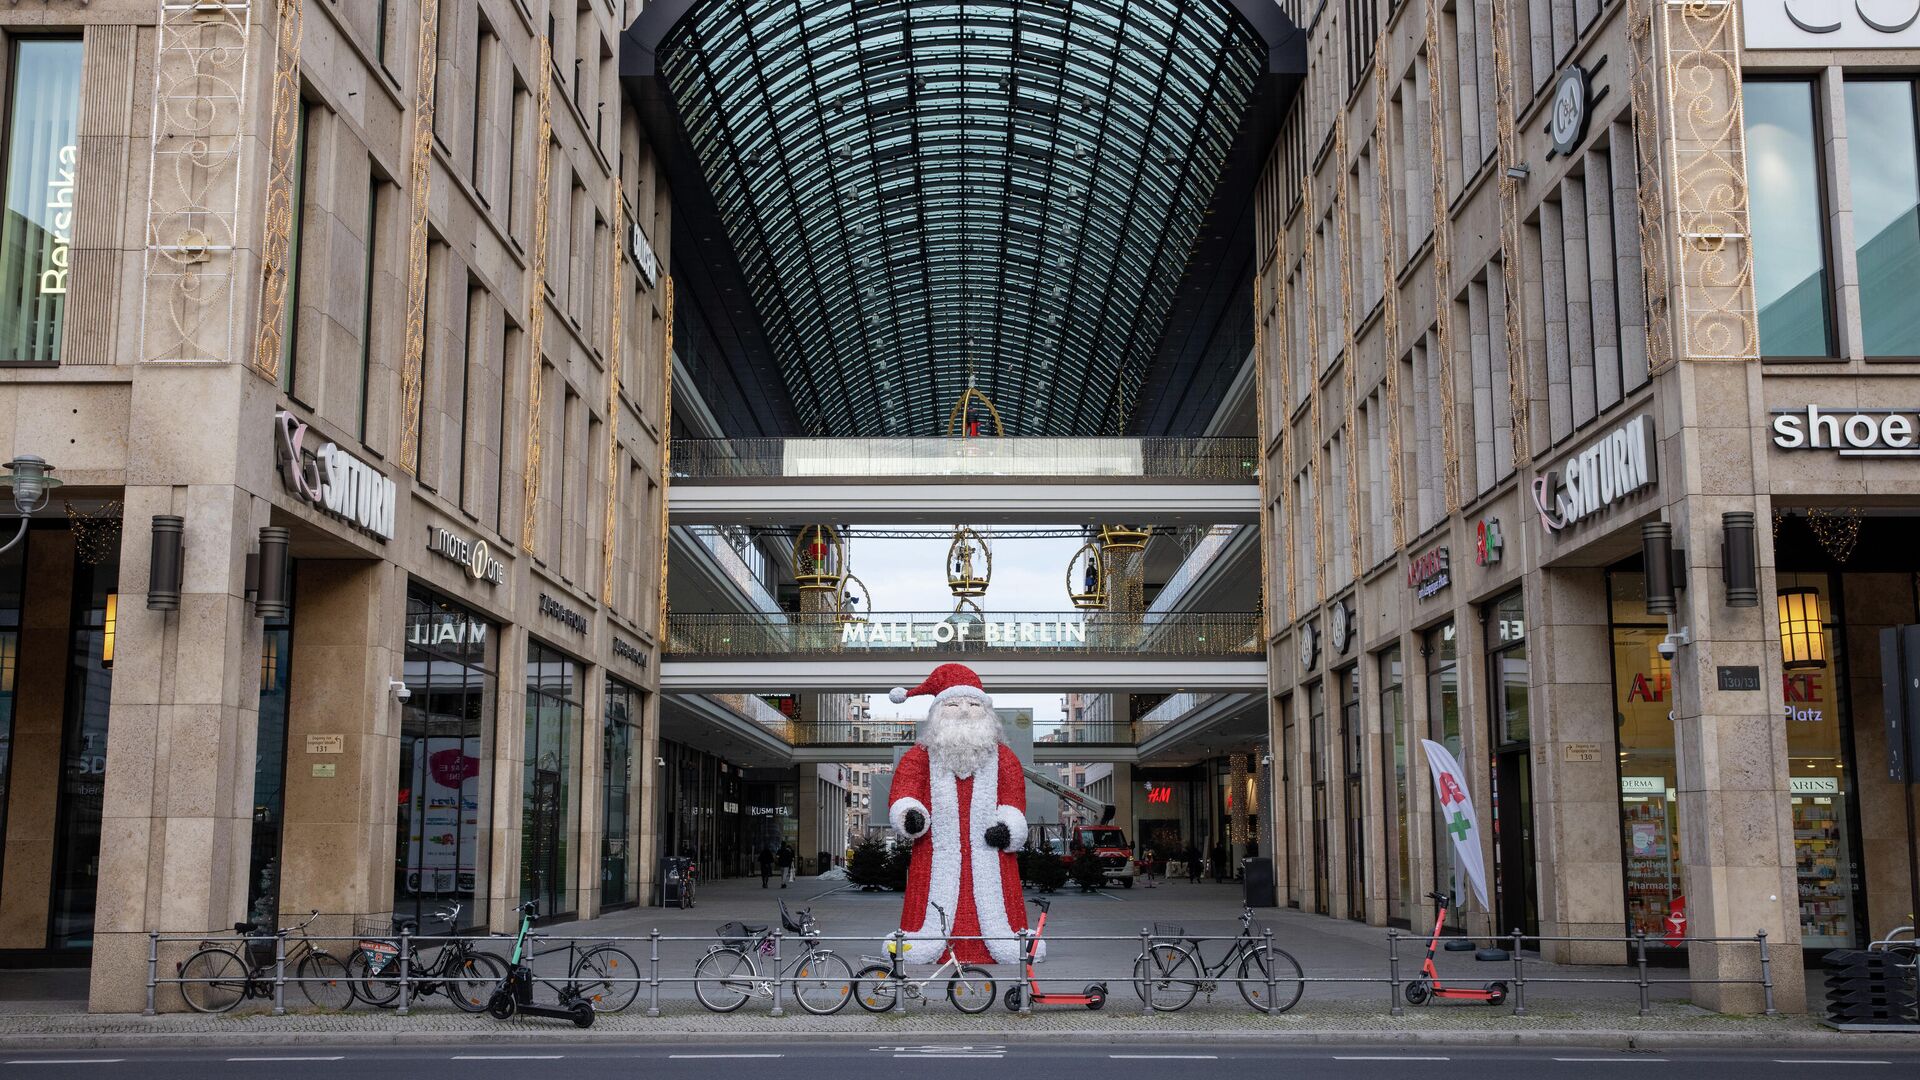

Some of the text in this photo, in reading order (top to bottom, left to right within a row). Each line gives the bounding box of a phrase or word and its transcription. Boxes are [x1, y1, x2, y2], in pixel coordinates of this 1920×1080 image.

[40, 145, 76, 294] Bershka
[1773, 404, 1920, 448] shoe
[1565, 414, 1649, 524] SATURN
[318, 442, 396, 541] SATURN
[440, 528, 471, 567] MOTEL
[487, 557, 504, 585] ONE
[565, 608, 587, 635] HOM
[841, 622, 1086, 643] MALL OF BERLIN
[1724, 677, 1758, 688] 130/131
[1784, 705, 1823, 721] Platz
[1147, 786, 1171, 804] H&M
[751, 806, 789, 816] KUSMI TEA
